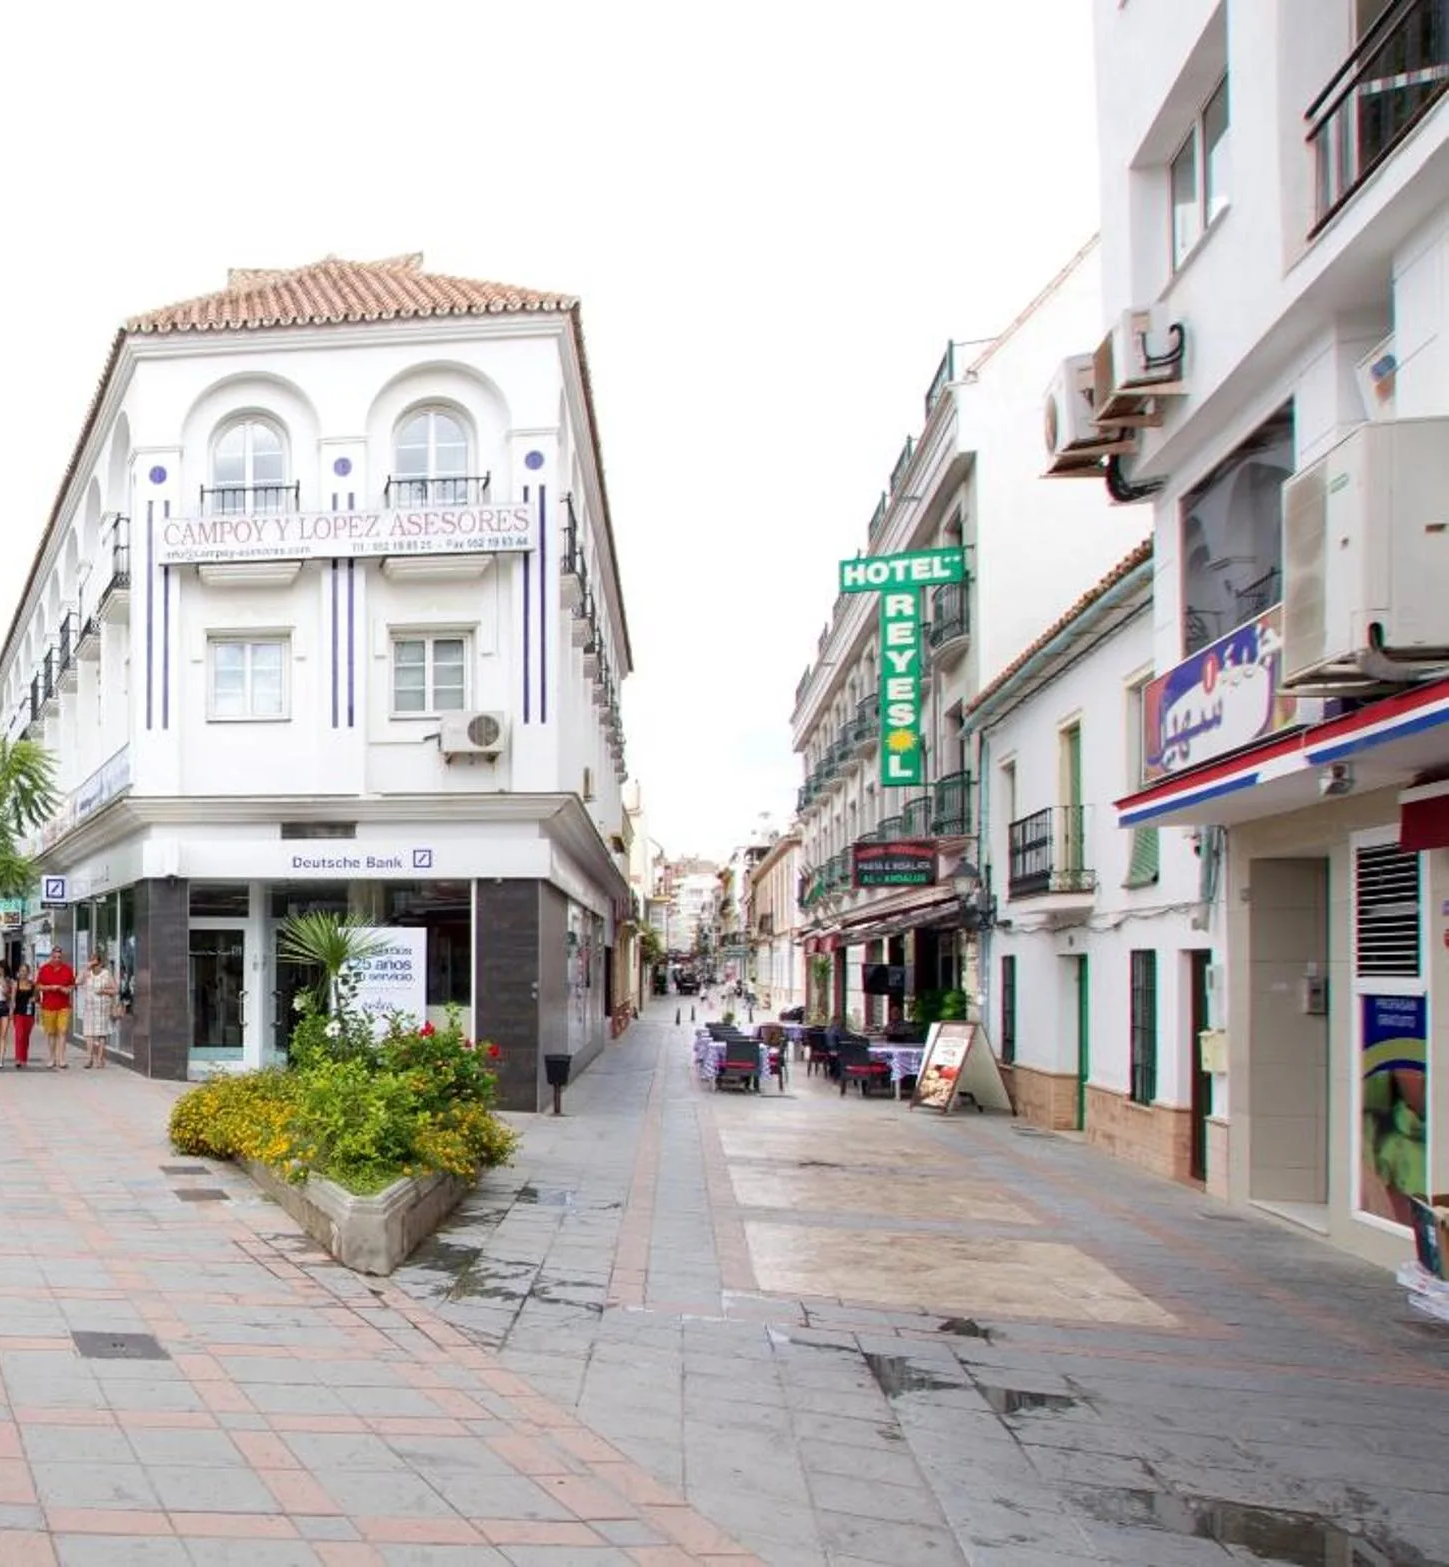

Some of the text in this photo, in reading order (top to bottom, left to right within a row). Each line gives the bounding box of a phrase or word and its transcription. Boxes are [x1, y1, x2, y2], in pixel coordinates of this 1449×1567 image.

[164, 508, 529, 546] CAMPOY Y LOPEZ ASESORES
[843, 556, 952, 587] HOTEL
[292, 855, 403, 869] Deutsche Bank
